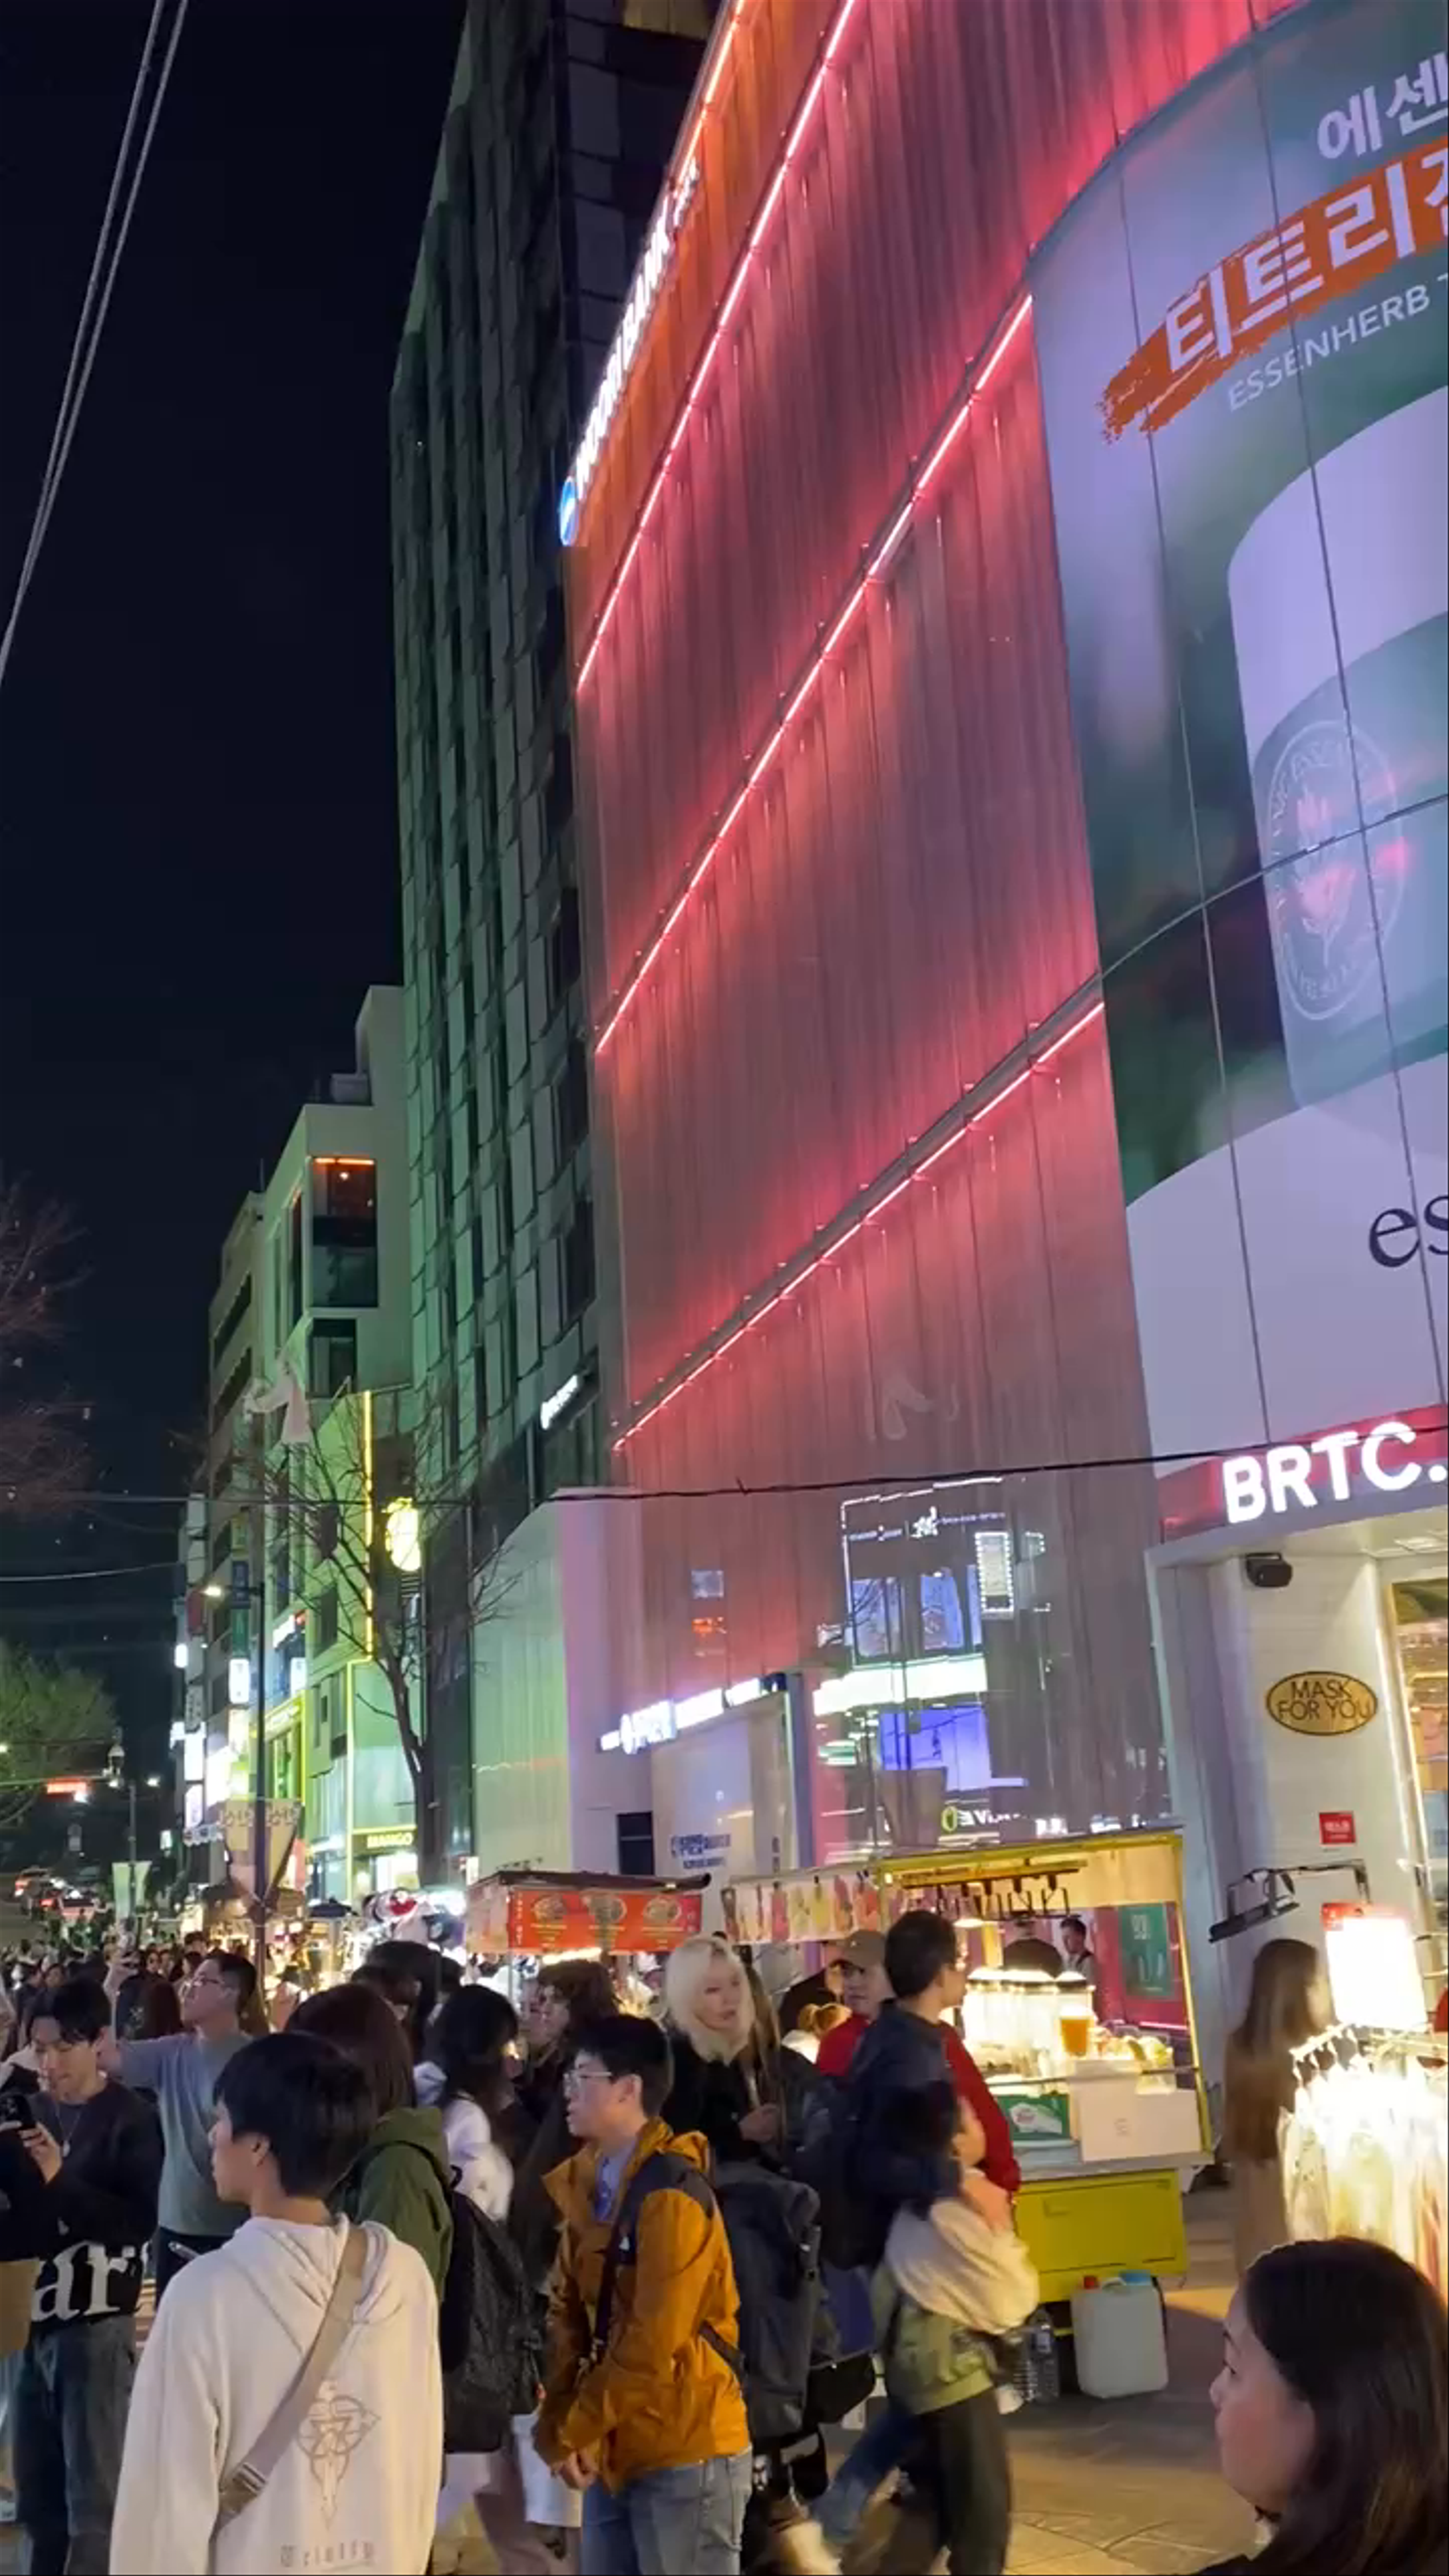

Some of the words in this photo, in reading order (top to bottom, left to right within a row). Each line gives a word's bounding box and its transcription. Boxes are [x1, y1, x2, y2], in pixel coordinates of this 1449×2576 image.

[1228, 285, 1430, 412] ESSENHERB
[1222, 1421, 1447, 1524] BRTC.
[1278, 1699, 1320, 1721] FOR
[1325, 1698, 1371, 1720] YOU
[1291, 1680, 1352, 1699] MASK
